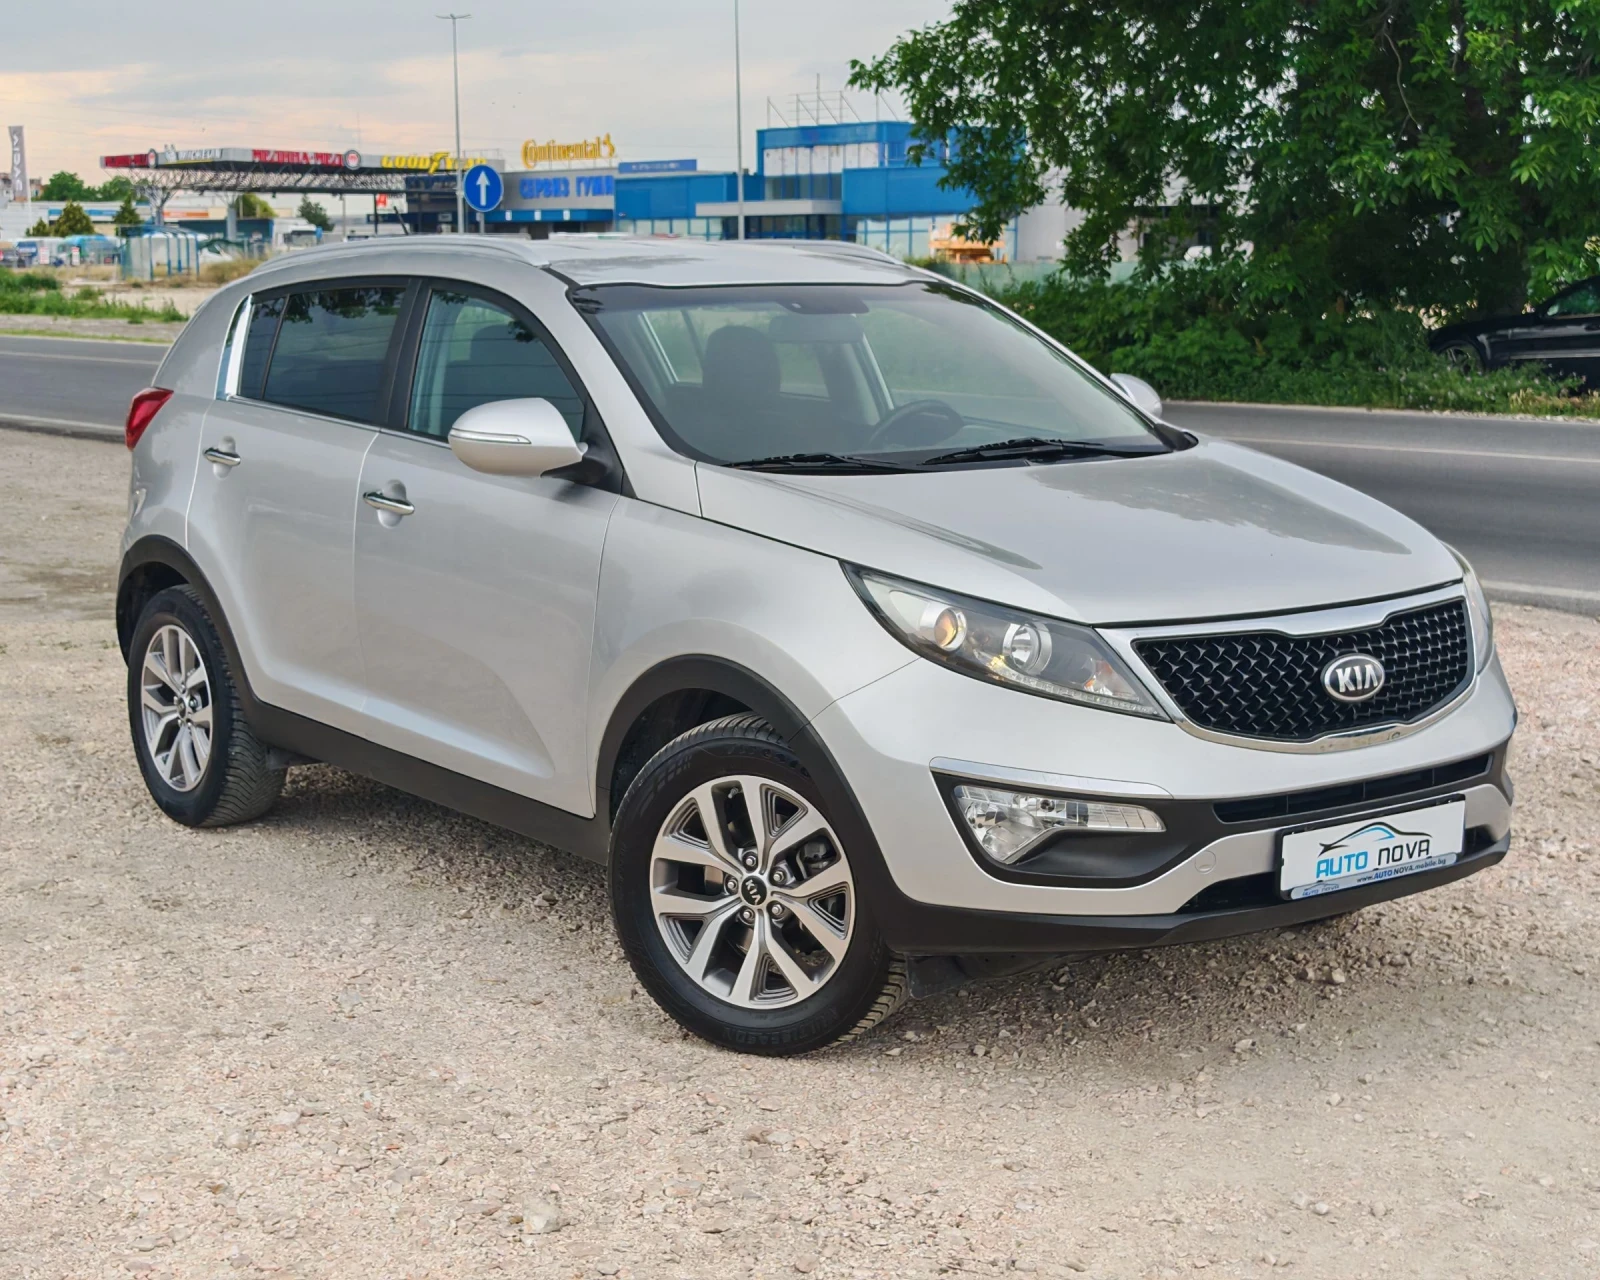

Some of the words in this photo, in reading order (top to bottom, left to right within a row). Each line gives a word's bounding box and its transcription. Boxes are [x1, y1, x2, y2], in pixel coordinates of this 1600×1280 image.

[521, 136, 601, 169] Continental
[1336, 664, 1379, 692] KIA
[1315, 851, 1368, 879] AUTO
[1377, 839, 1430, 866] NOVA
[745, 879, 761, 905] KIA
